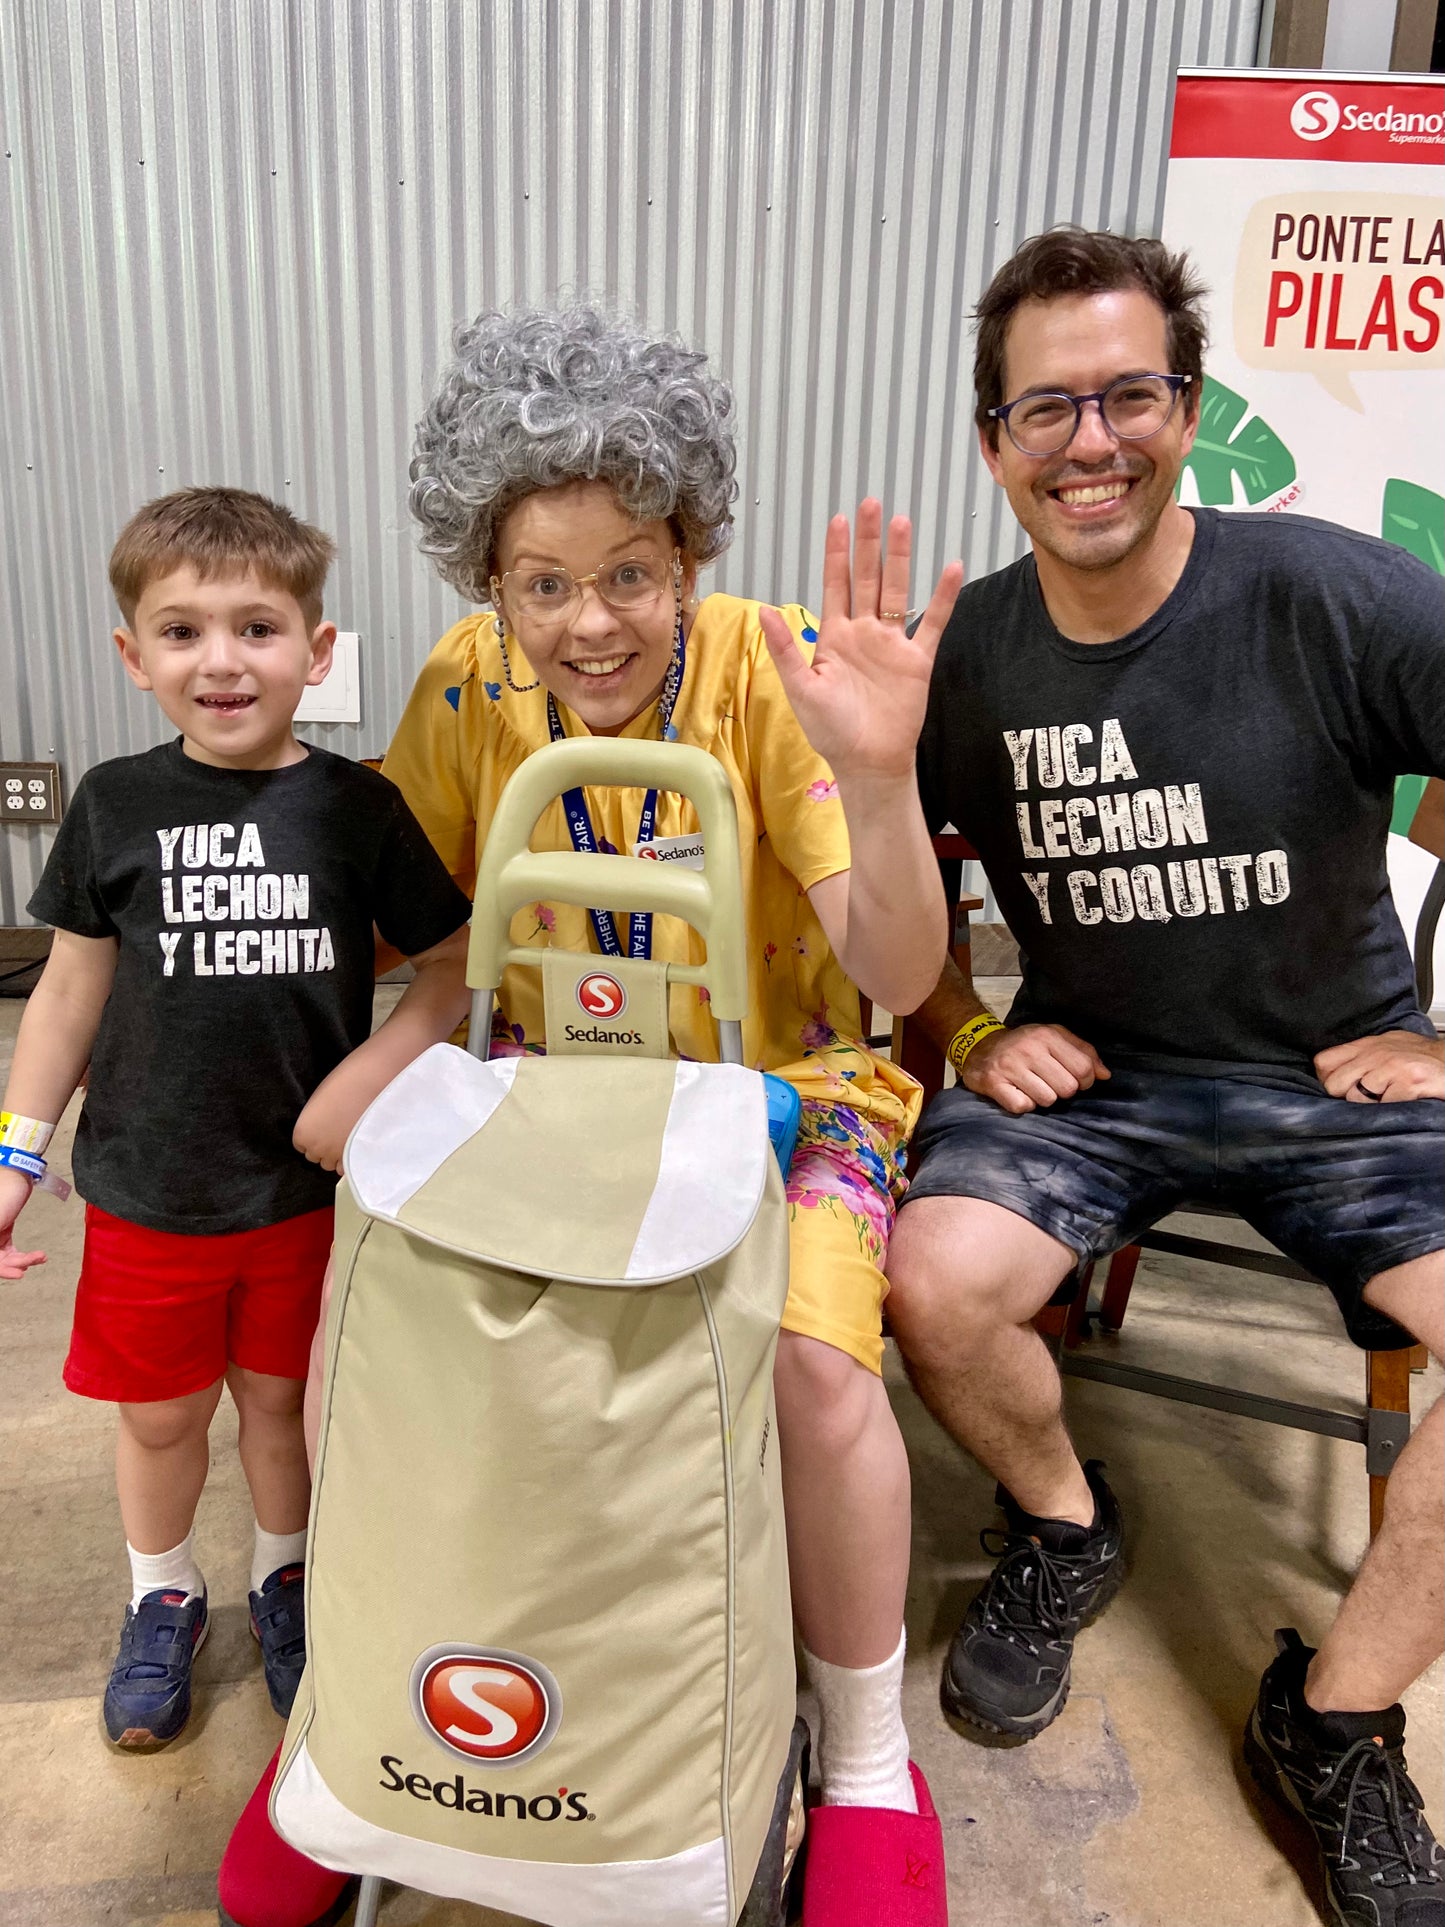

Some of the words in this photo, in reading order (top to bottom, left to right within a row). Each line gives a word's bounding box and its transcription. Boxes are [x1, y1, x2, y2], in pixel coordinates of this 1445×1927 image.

[1341, 104, 1445, 133] Sedano'
[1388, 132, 1445, 145] Supermarke
[1271, 213, 1392, 264] PONTE
[1263, 270, 1444, 353] PILAS
[1266, 484, 1302, 513] arket
[1002, 718, 1139, 791] YUCA
[641, 810, 652, 829] BE
[1015, 782, 1209, 859] LECHON
[156, 822, 266, 871] YUCA
[657, 844, 705, 862] Sedano's
[161, 874, 310, 924] LECHON
[1021, 871, 1053, 925] Y
[1066, 849, 1291, 925] COQUITO
[634, 913, 646, 931] HE
[158, 932, 182, 977] Y
[193, 927, 336, 976] LECHITA
[633, 935, 646, 959] FAI
[565, 1025, 643, 1045] Sedano's
[379, 1755, 590, 1822] Sedano's
